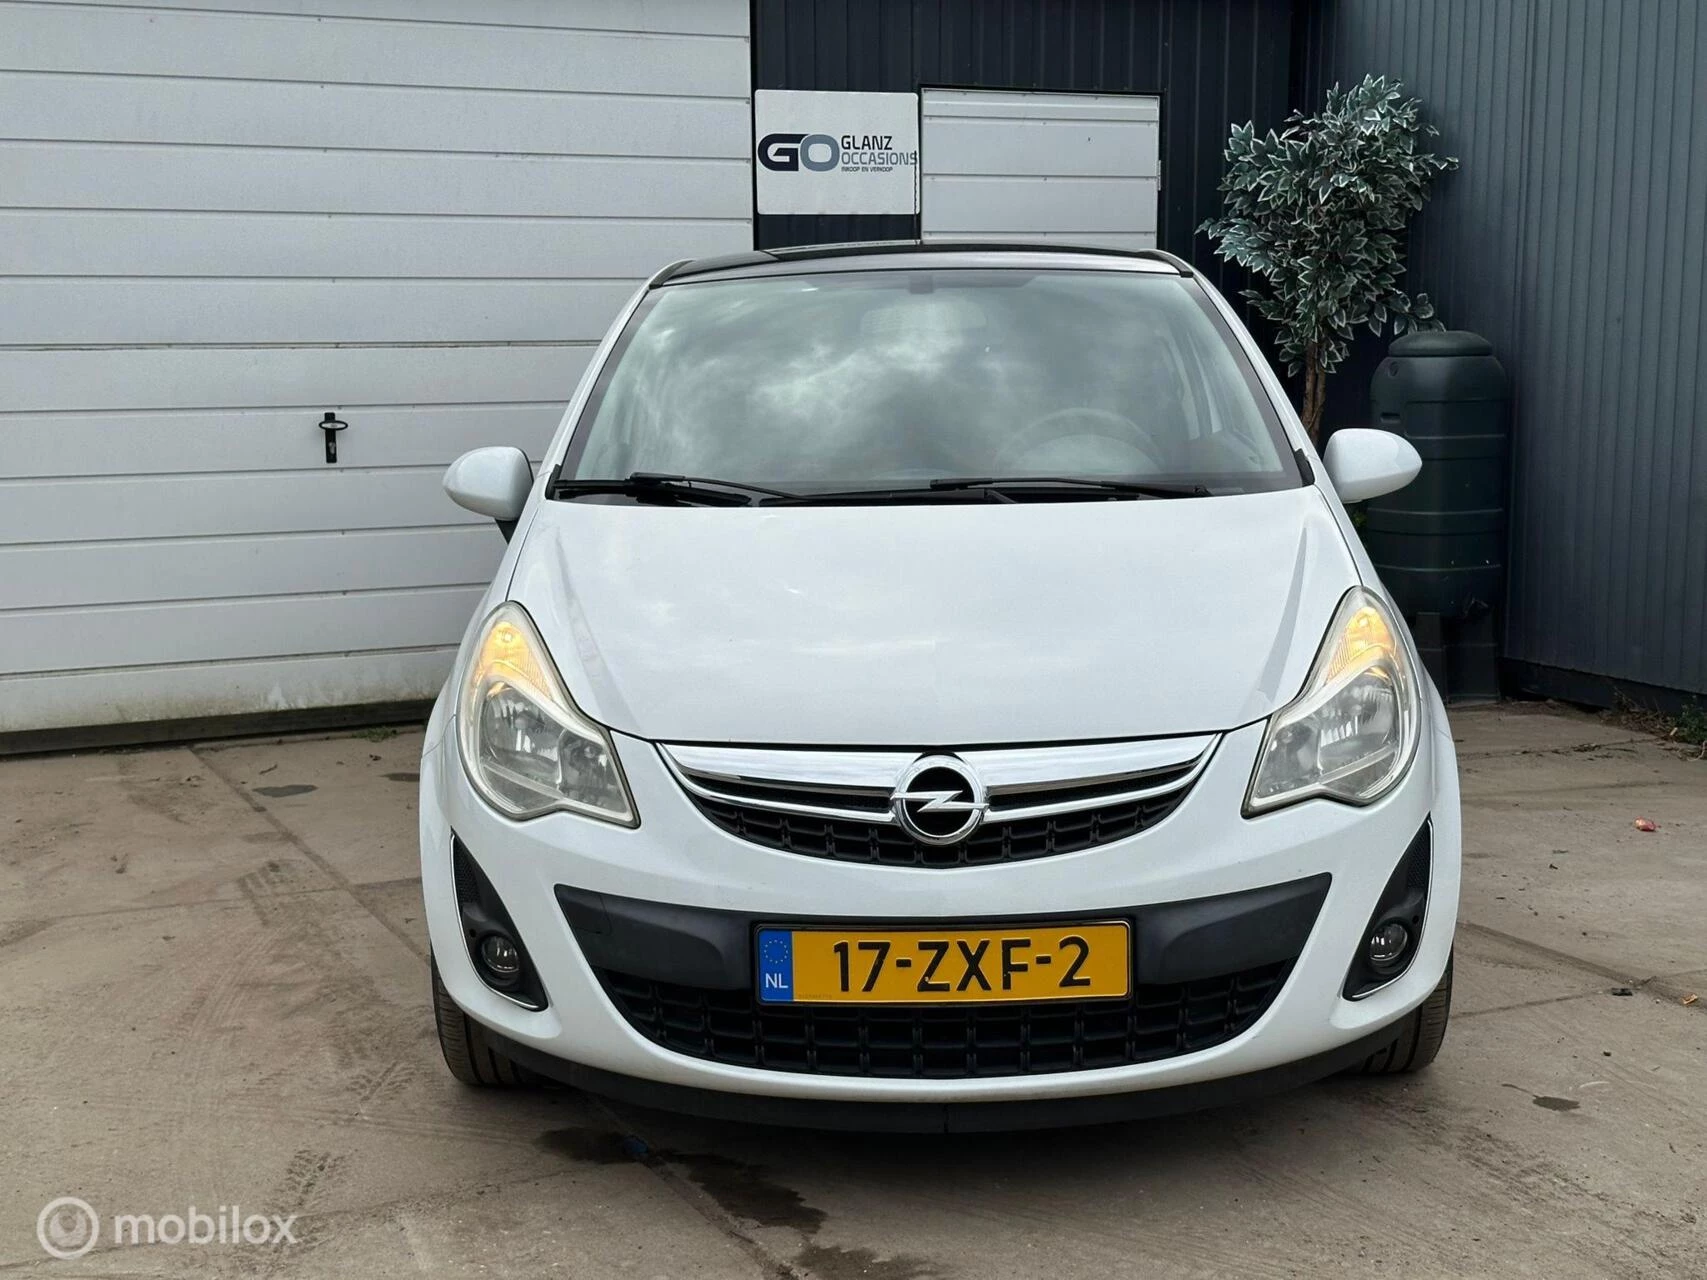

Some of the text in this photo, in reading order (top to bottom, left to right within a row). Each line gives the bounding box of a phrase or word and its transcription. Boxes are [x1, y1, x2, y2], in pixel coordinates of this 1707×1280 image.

[841, 135, 893, 150] GLANZ
[758, 133, 840, 172] GO
[841, 152, 917, 166] OCCASIONS
[832, 934, 1092, 993] 17-ZXF-2
[765, 973, 788, 989] NL
